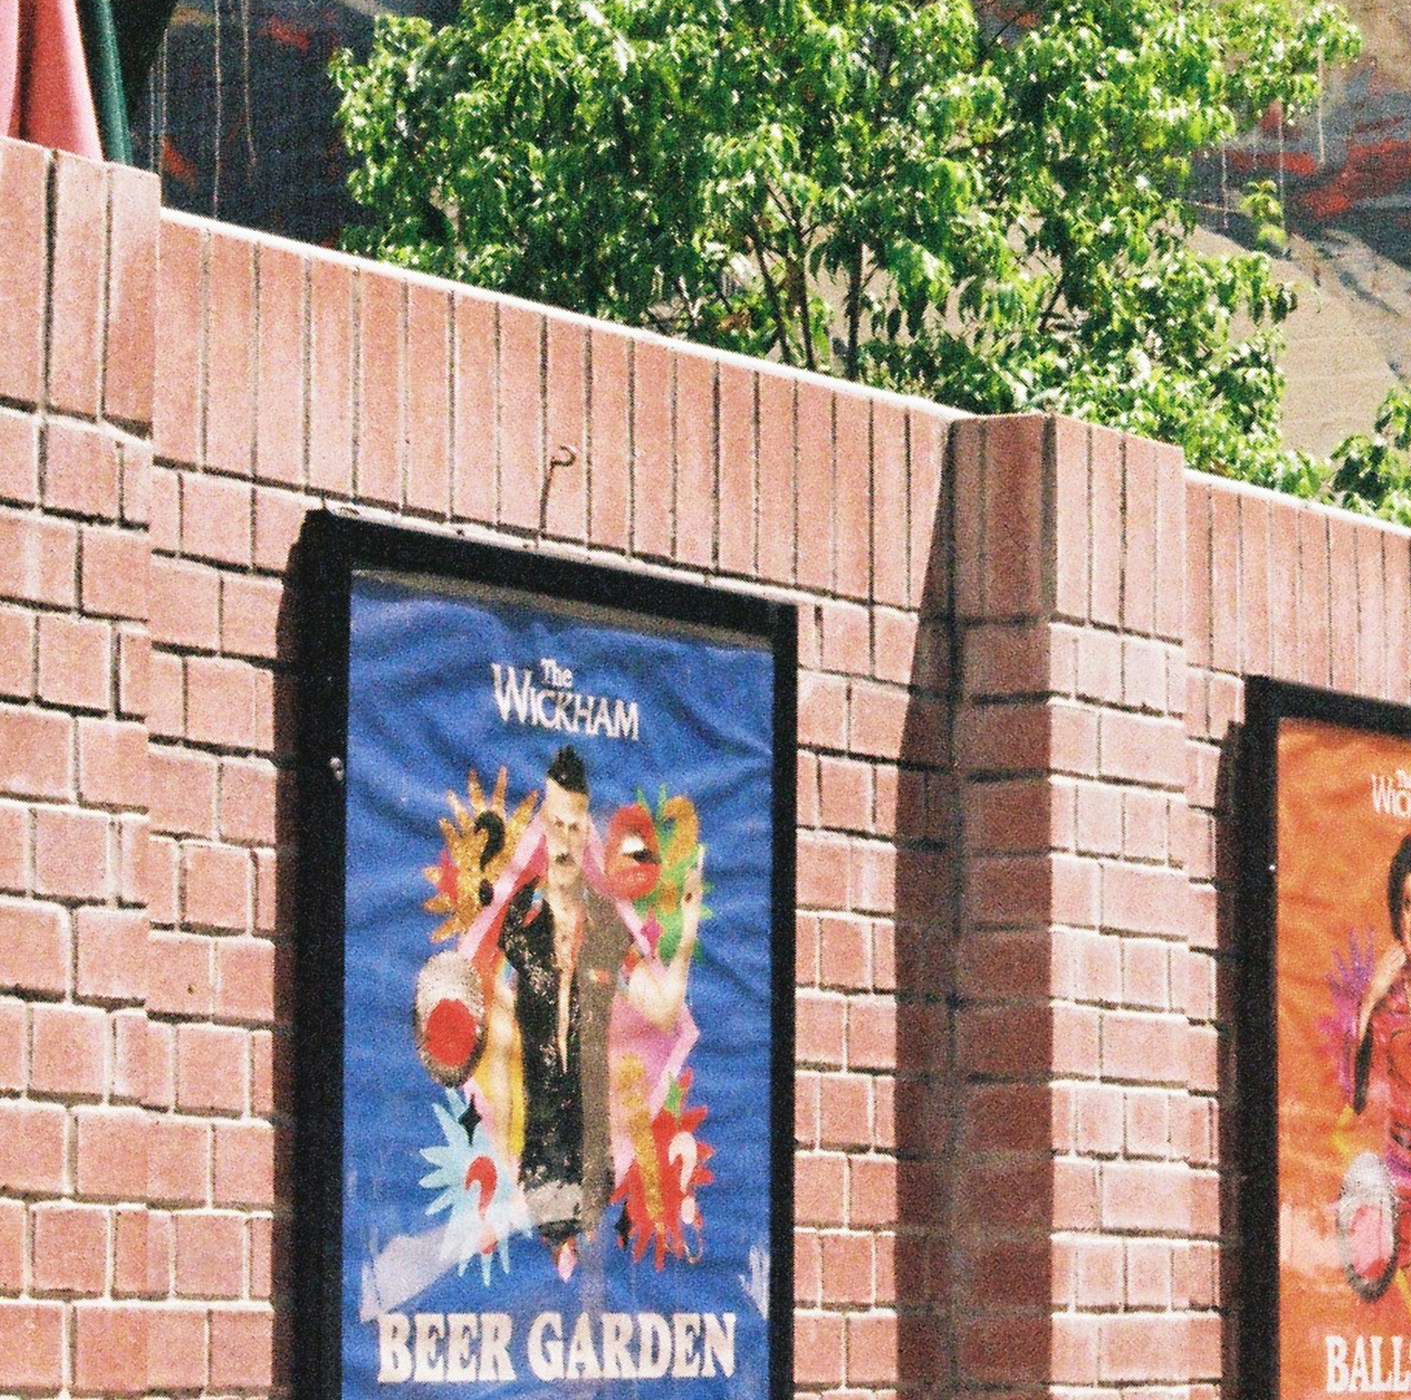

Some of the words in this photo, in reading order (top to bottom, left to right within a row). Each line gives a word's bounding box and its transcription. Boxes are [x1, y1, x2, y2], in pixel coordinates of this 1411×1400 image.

[540, 657, 574, 688] The
[377, 1311, 516, 1383] BEER
[527, 1311, 738, 1382] GARDEN
